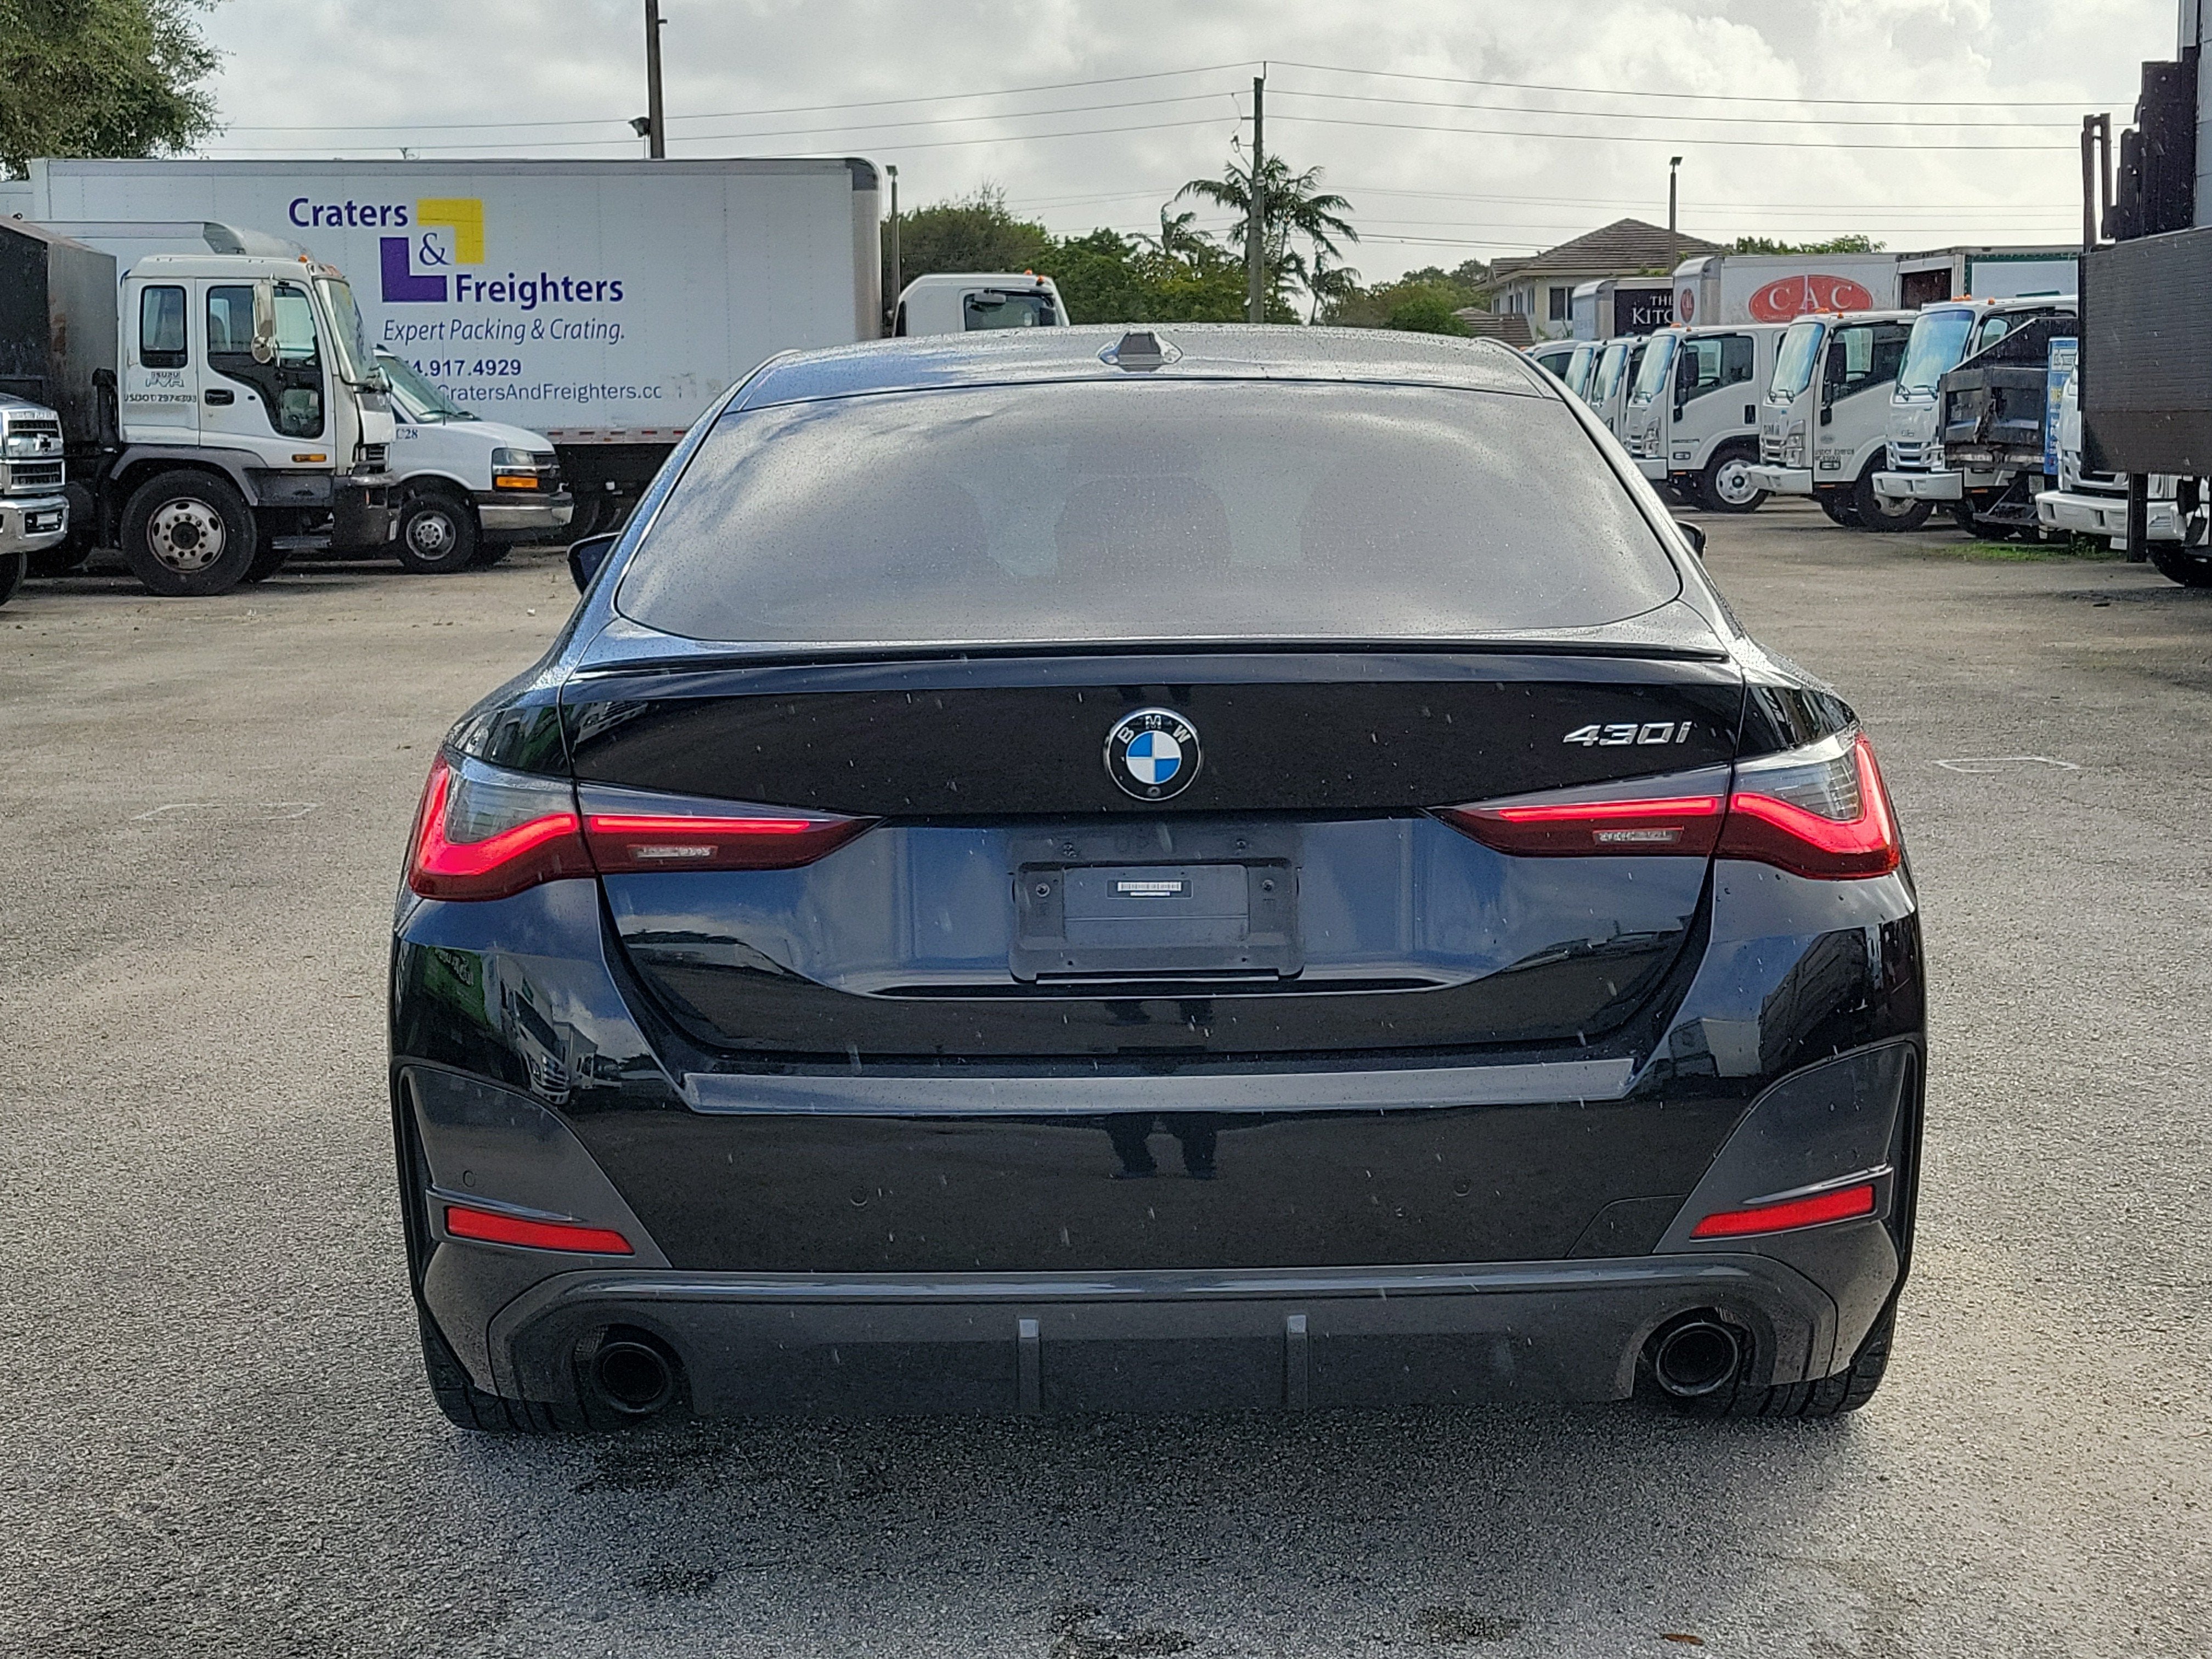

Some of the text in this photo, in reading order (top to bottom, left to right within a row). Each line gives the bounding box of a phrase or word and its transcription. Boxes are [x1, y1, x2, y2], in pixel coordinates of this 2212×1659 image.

[289, 198, 409, 227] Craters
[419, 232, 450, 266] &
[456, 272, 624, 310] Freighters
[1769, 285, 1853, 311] CAC
[383, 317, 625, 346] Expert Packing & Crating.
[404, 359, 522, 376] 4.917.4929
[1117, 715, 1192, 744] BMW
[1562, 721, 1692, 746] 430i
